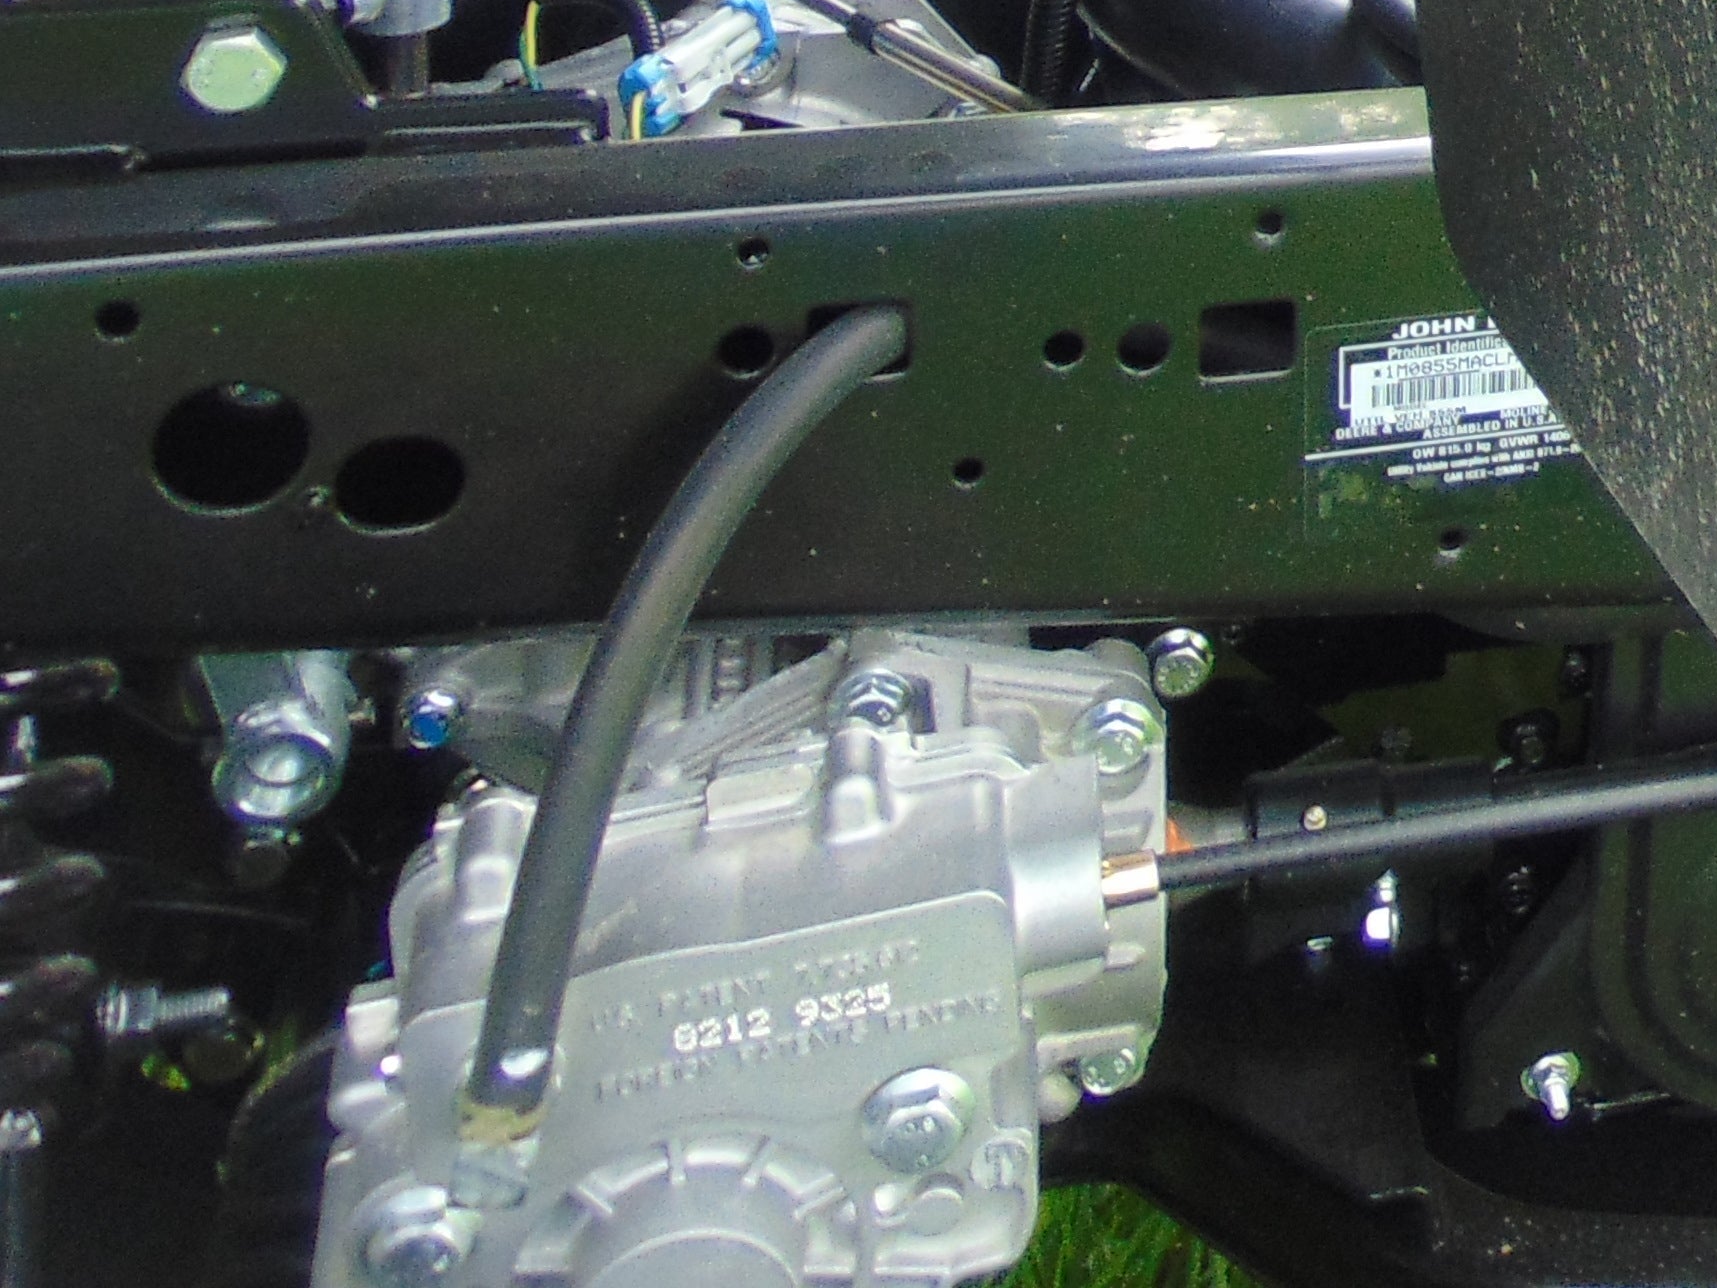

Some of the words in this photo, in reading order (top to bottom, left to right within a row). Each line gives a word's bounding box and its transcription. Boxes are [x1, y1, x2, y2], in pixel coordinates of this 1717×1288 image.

[1392, 316, 1475, 340] JOHN
[1388, 341, 1441, 361] Product
[1335, 425, 1378, 440] DEERE
[1396, 415, 1461, 433] COMPANY
[1422, 420, 1500, 439] ASSEMBLED
[1505, 417, 1518, 429] IN
[1500, 435, 1538, 449] GVWR
